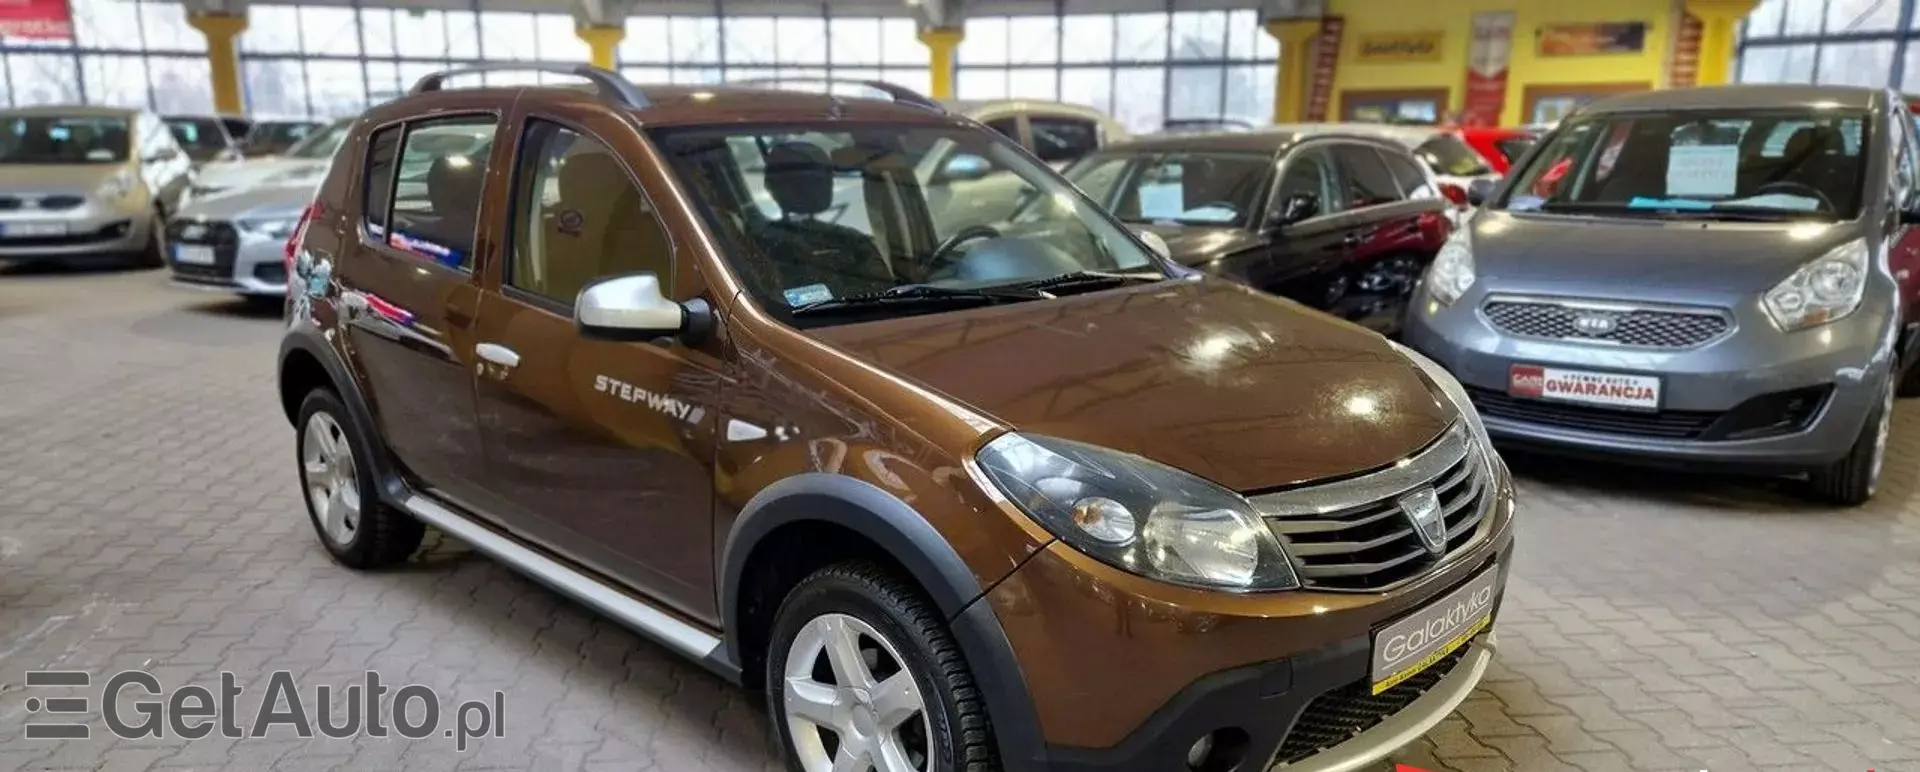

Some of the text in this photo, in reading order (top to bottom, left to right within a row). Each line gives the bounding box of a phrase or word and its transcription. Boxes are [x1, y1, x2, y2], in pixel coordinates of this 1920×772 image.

[594, 374, 690, 419] STEPWAY
[1545, 379, 1655, 400] GWARANCJA
[1383, 585, 1492, 662] Galaktyka
